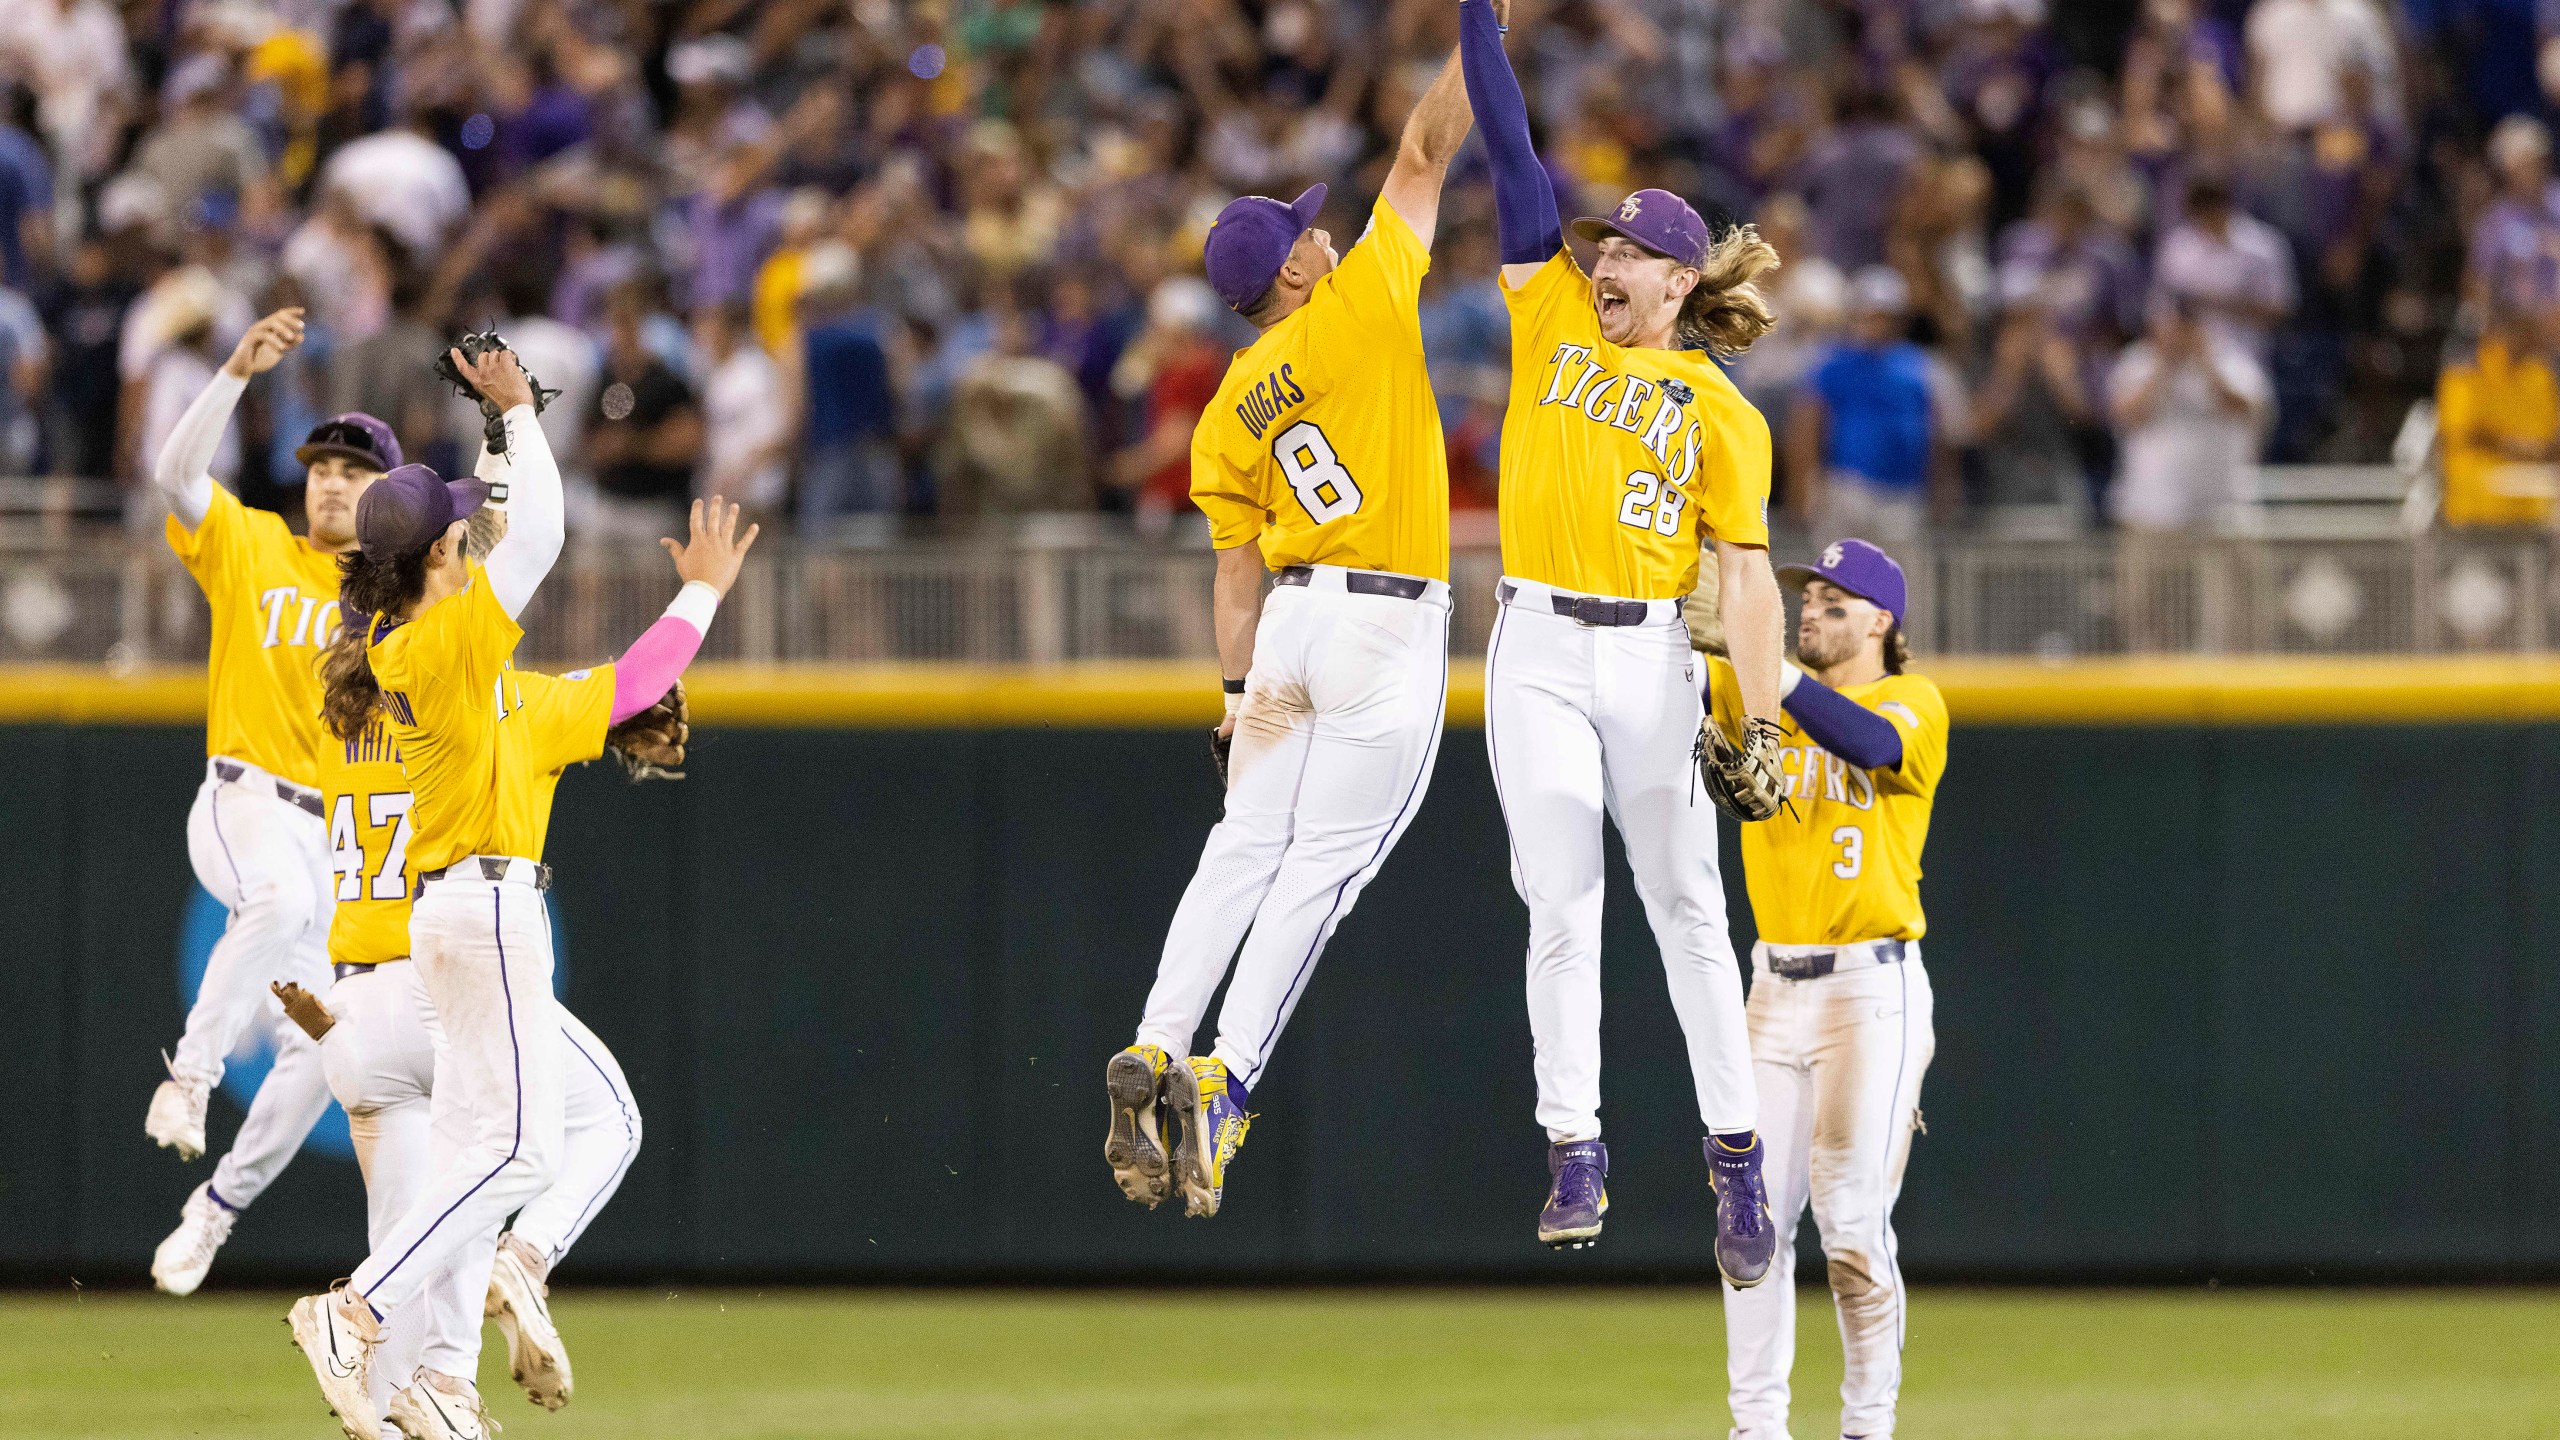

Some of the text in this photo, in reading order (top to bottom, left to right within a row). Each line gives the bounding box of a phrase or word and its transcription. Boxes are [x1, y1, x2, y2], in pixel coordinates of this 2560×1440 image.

[1236, 363, 1305, 441] DUGAS
[1539, 342, 1702, 487] TIGERS
[1272, 420, 1364, 526] 8
[1618, 470, 1687, 538] 28
[260, 586, 341, 651] TIG
[1779, 746, 1875, 811] GERS
[329, 791, 415, 902] 47
[1831, 825, 1863, 880] 3
[1212, 1117, 1227, 1144] DUGAS
[1565, 1150, 1597, 1158] TIGERS
[1718, 1160, 1750, 1168] TIGERS
